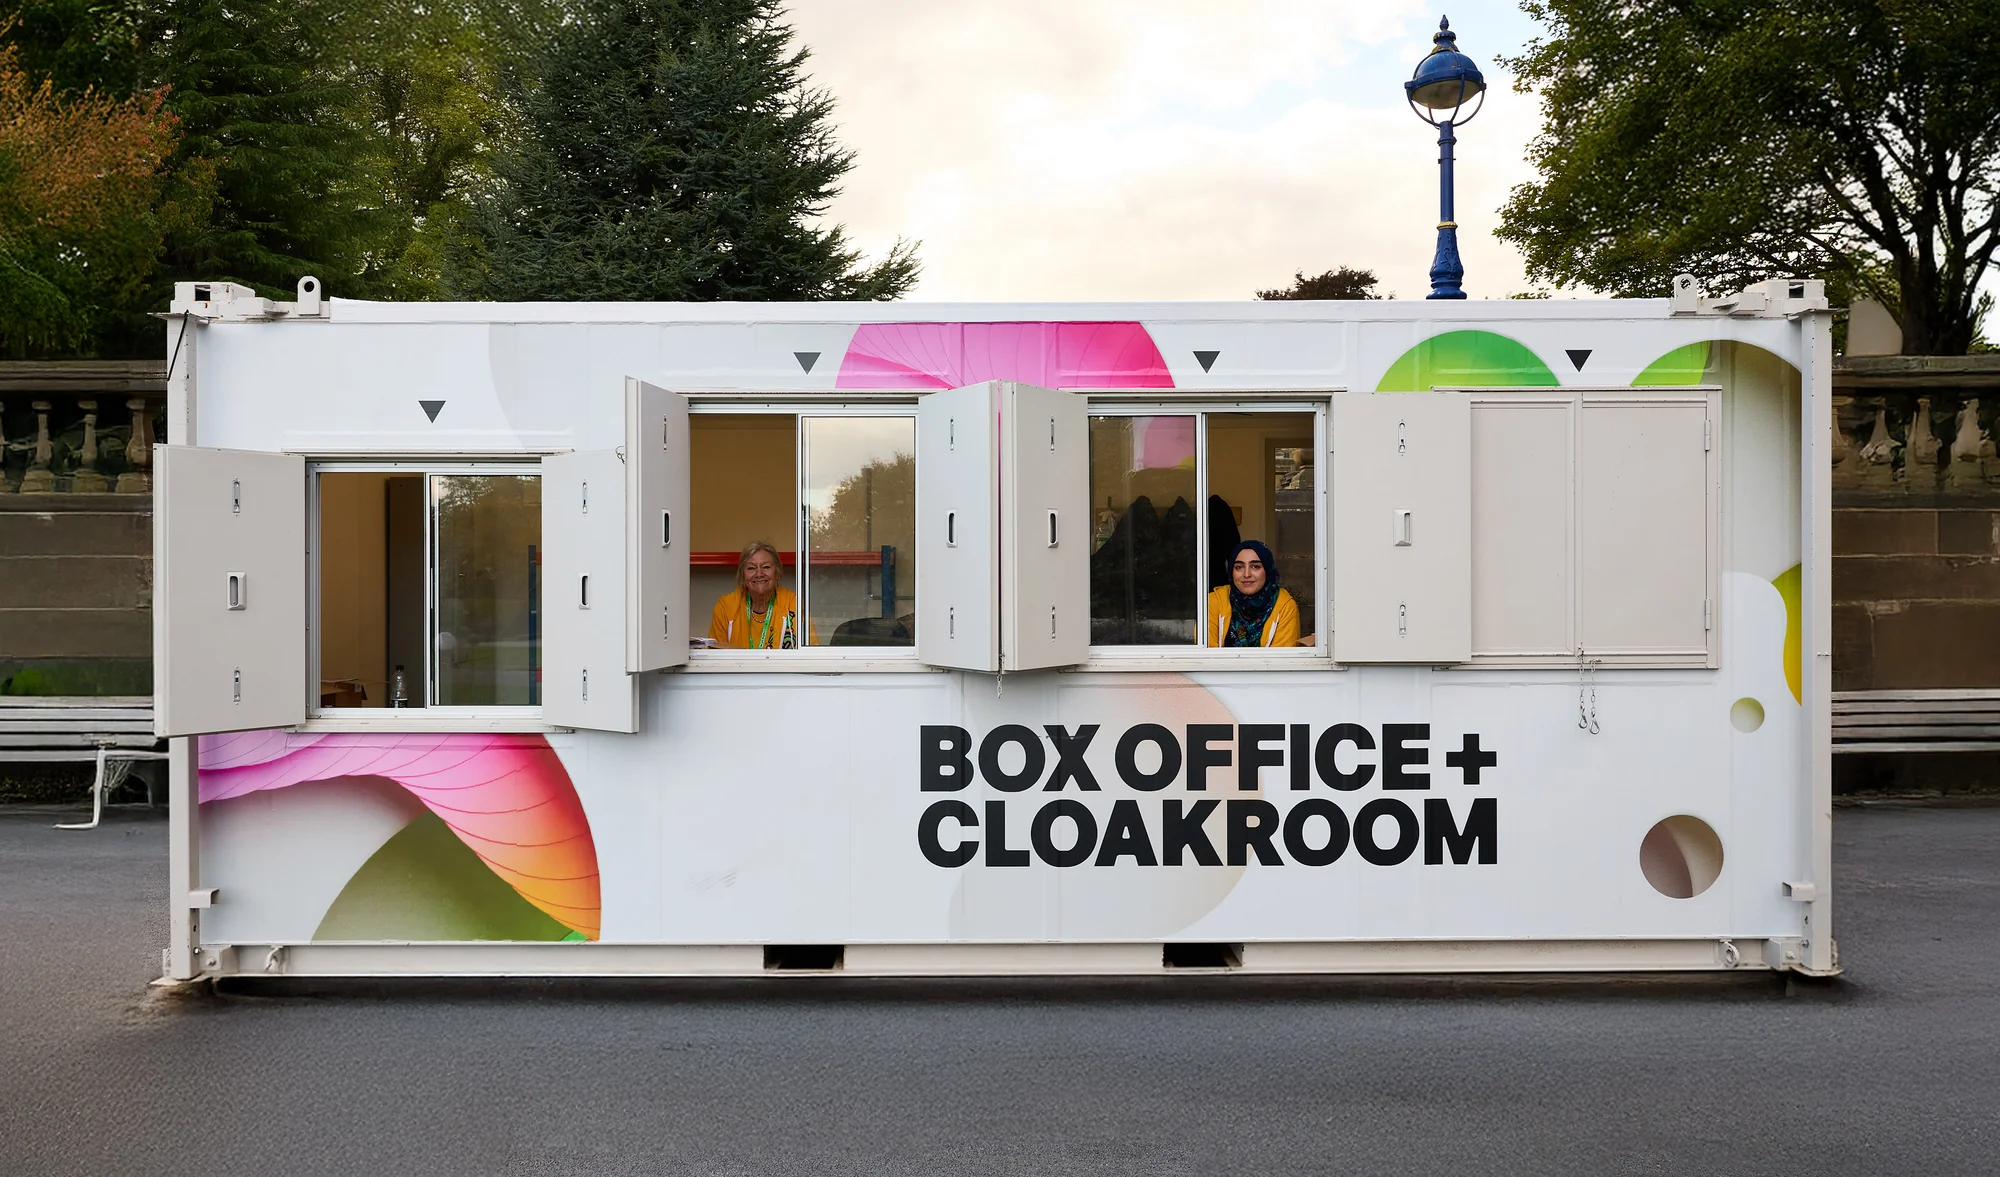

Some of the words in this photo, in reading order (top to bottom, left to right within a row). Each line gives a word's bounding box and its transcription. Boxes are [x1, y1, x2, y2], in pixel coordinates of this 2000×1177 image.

[920, 724, 1102, 793] BOX
[1114, 723, 1431, 792] OFFICE
[1445, 733, 1497, 785] +
[917, 797, 1498, 868] CLOAKROOM
